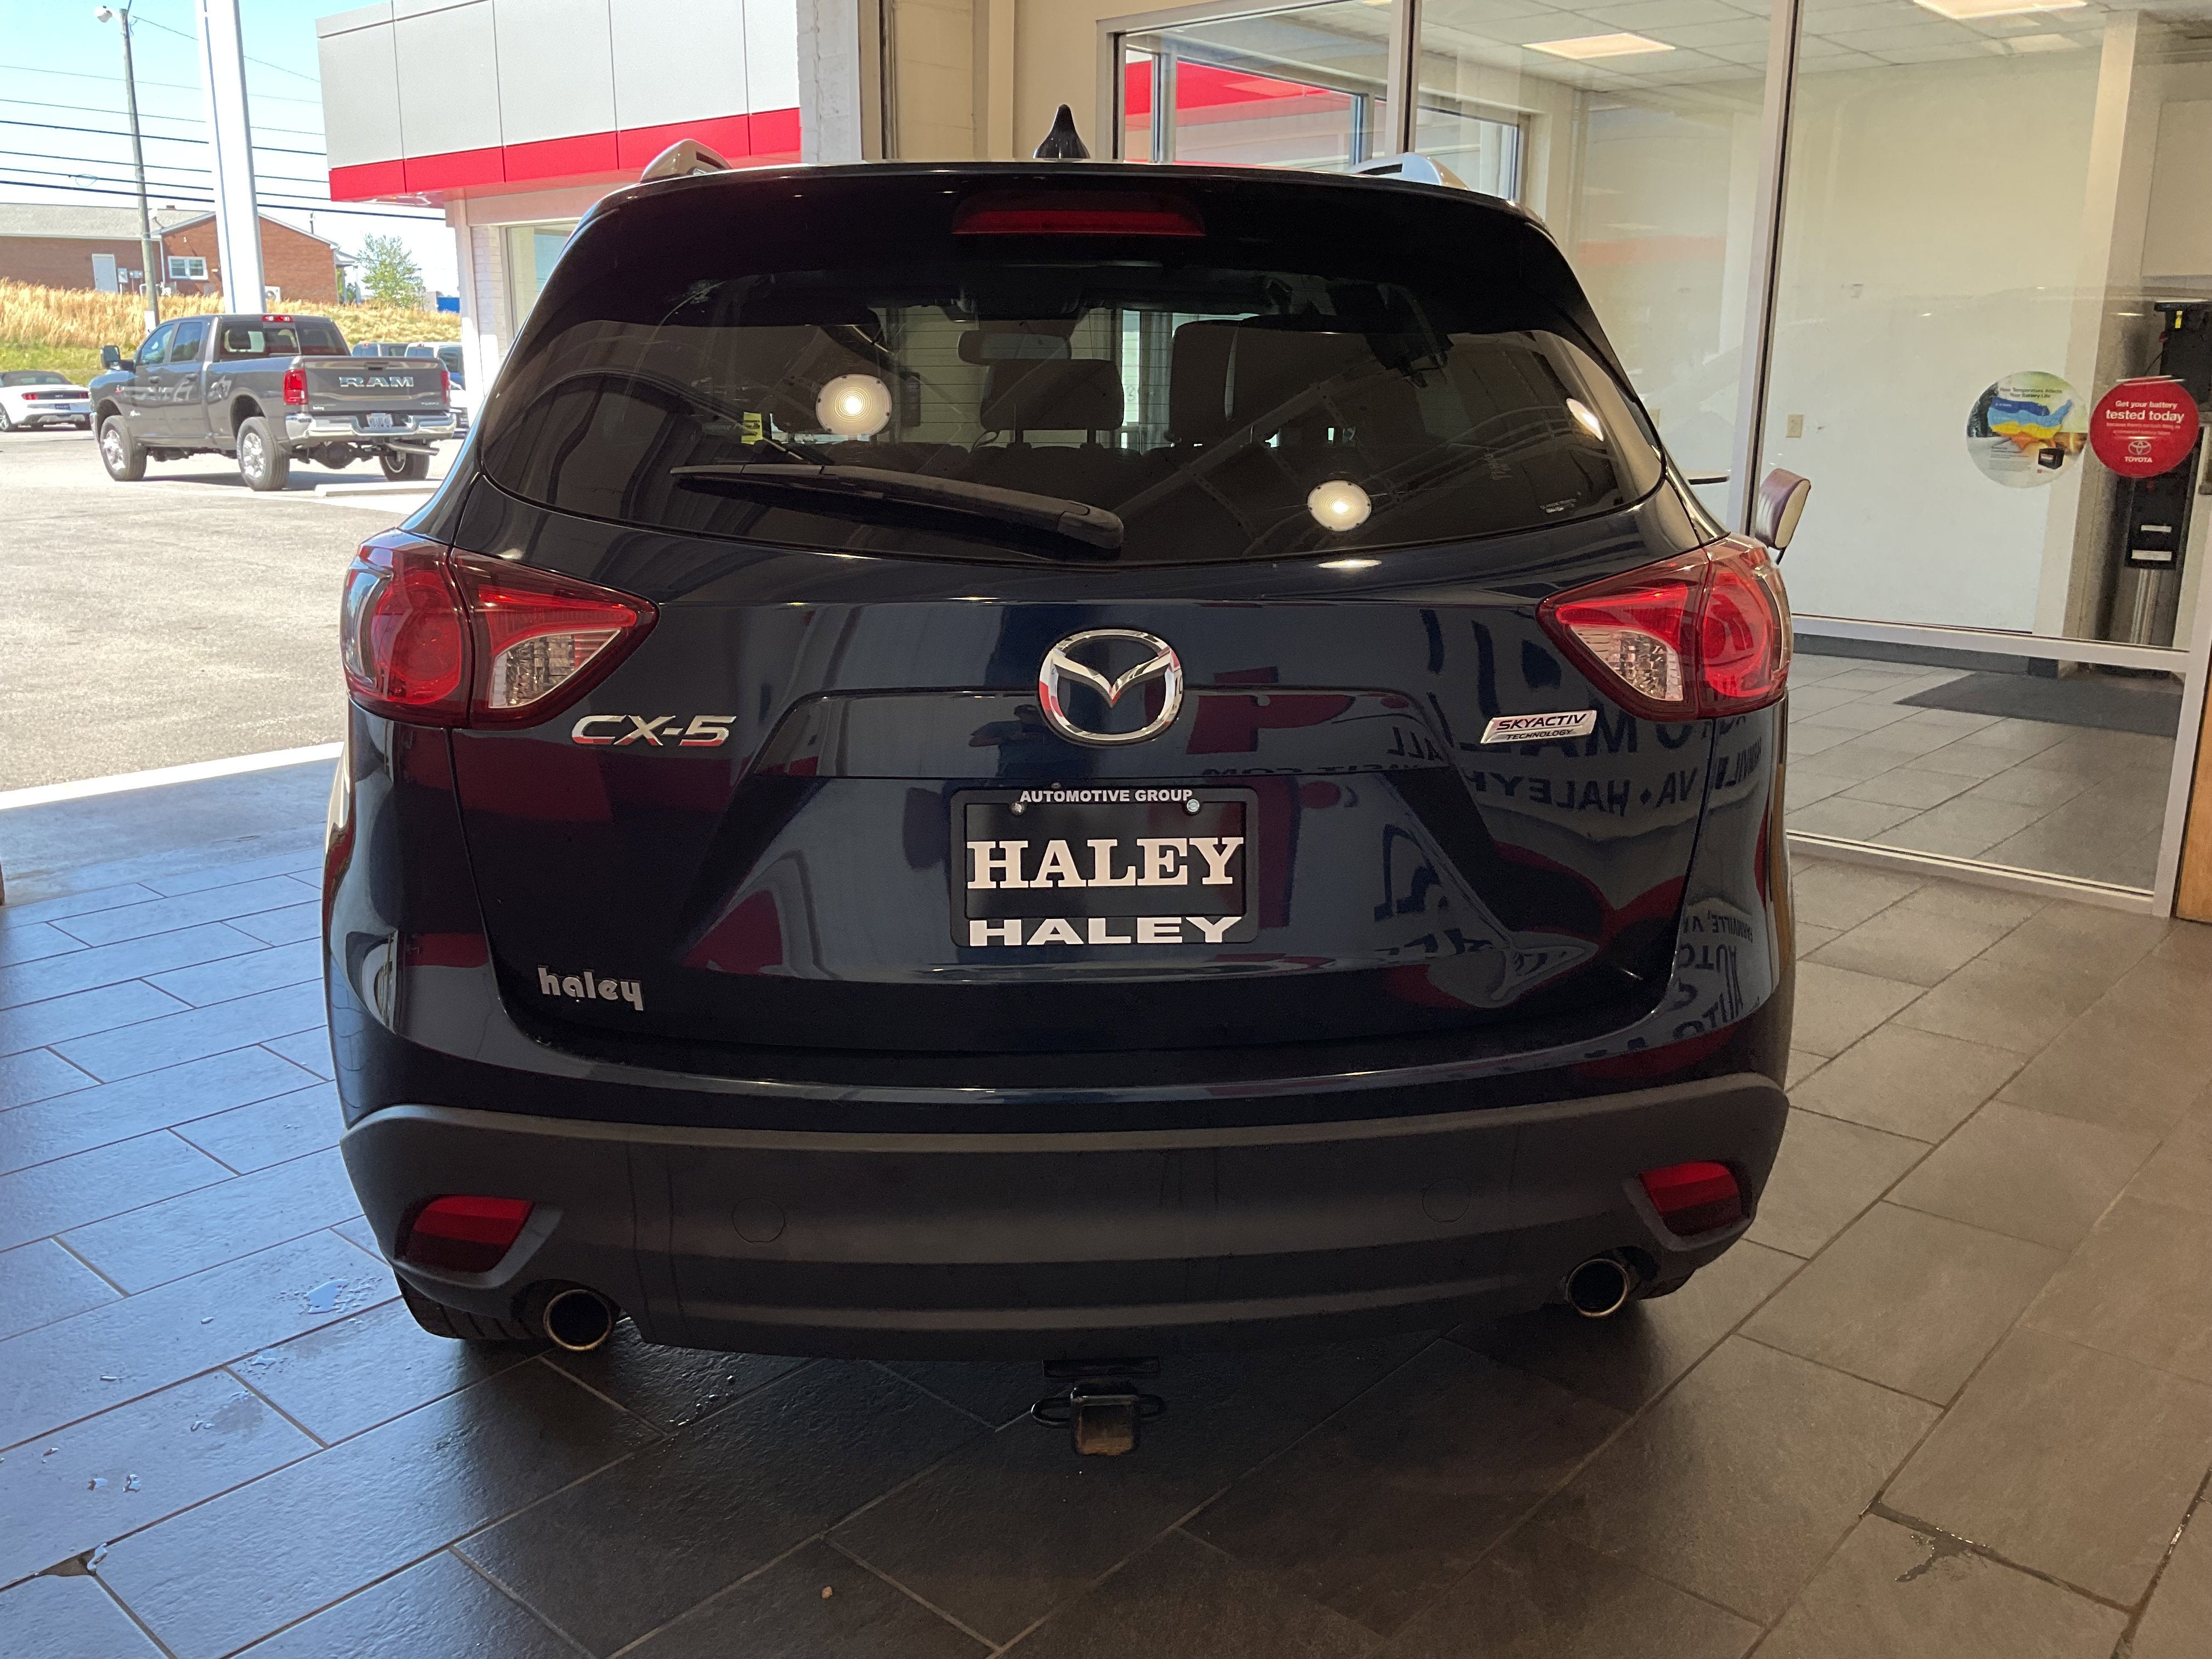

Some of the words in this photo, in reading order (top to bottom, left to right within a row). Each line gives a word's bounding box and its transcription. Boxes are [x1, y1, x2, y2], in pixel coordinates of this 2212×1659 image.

[338, 376, 414, 387] RAM
[2149, 401, 2178, 410] battery
[2106, 409, 2146, 420] tested
[2148, 410, 2185, 423] today
[1496, 714, 1587, 731] SKYACTIV
[571, 714, 737, 747] CX-5
[1506, 729, 1574, 741] TECHNOLOGY
[1020, 790, 1130, 803] AUTOMOTIVE
[1135, 789, 1193, 802] GROUP
[967, 837, 1244, 889] HALEY
[969, 916, 1242, 946] HALEY
[538, 965, 645, 1011] haley
